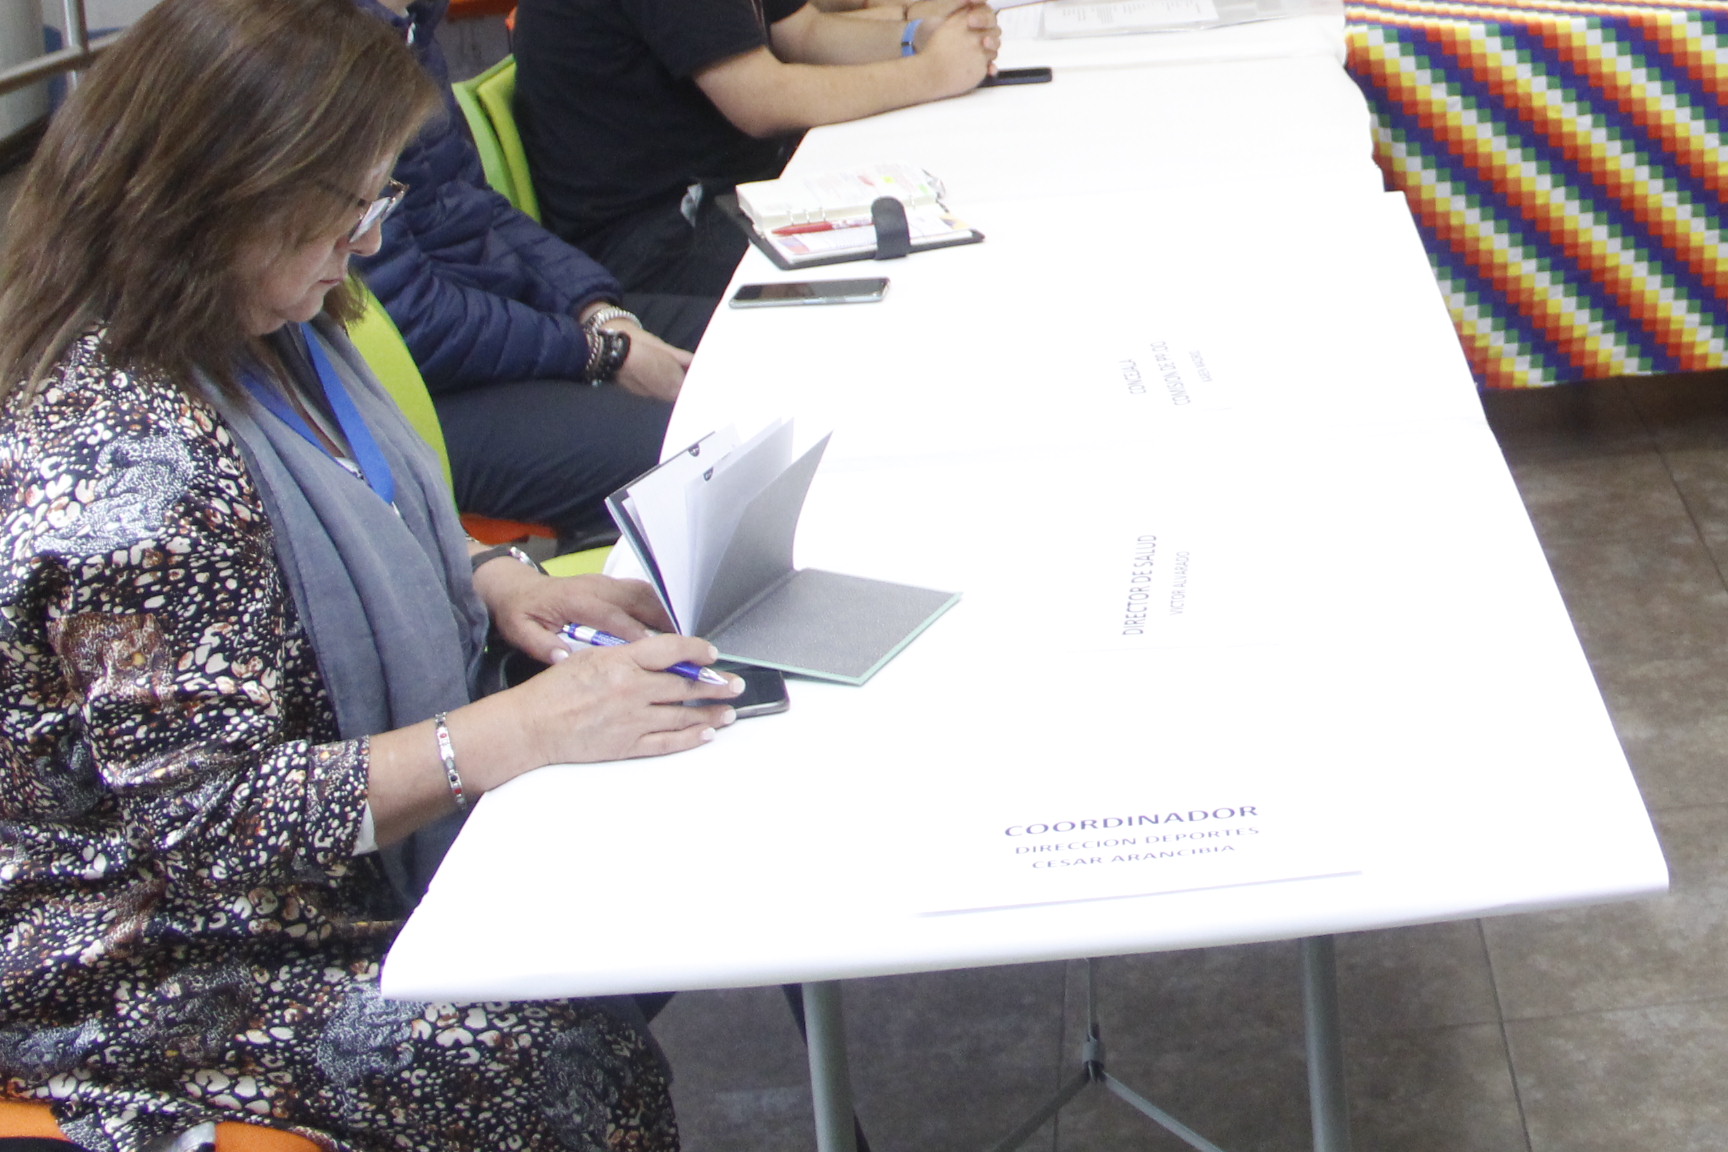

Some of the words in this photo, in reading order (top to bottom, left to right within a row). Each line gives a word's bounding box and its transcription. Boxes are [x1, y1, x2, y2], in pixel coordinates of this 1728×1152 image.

[1133, 535, 1157, 568] SALUD
[1130, 569, 1152, 584] DE
[1122, 586, 1150, 636] DIRECTOR
[1004, 805, 1259, 837] COORDINADOR
[1015, 837, 1137, 855] DIRECCION
[1145, 827, 1260, 844] DEPORTES
[1032, 855, 1103, 870] CESAR
[1111, 844, 1236, 863] ARANCIBIA
